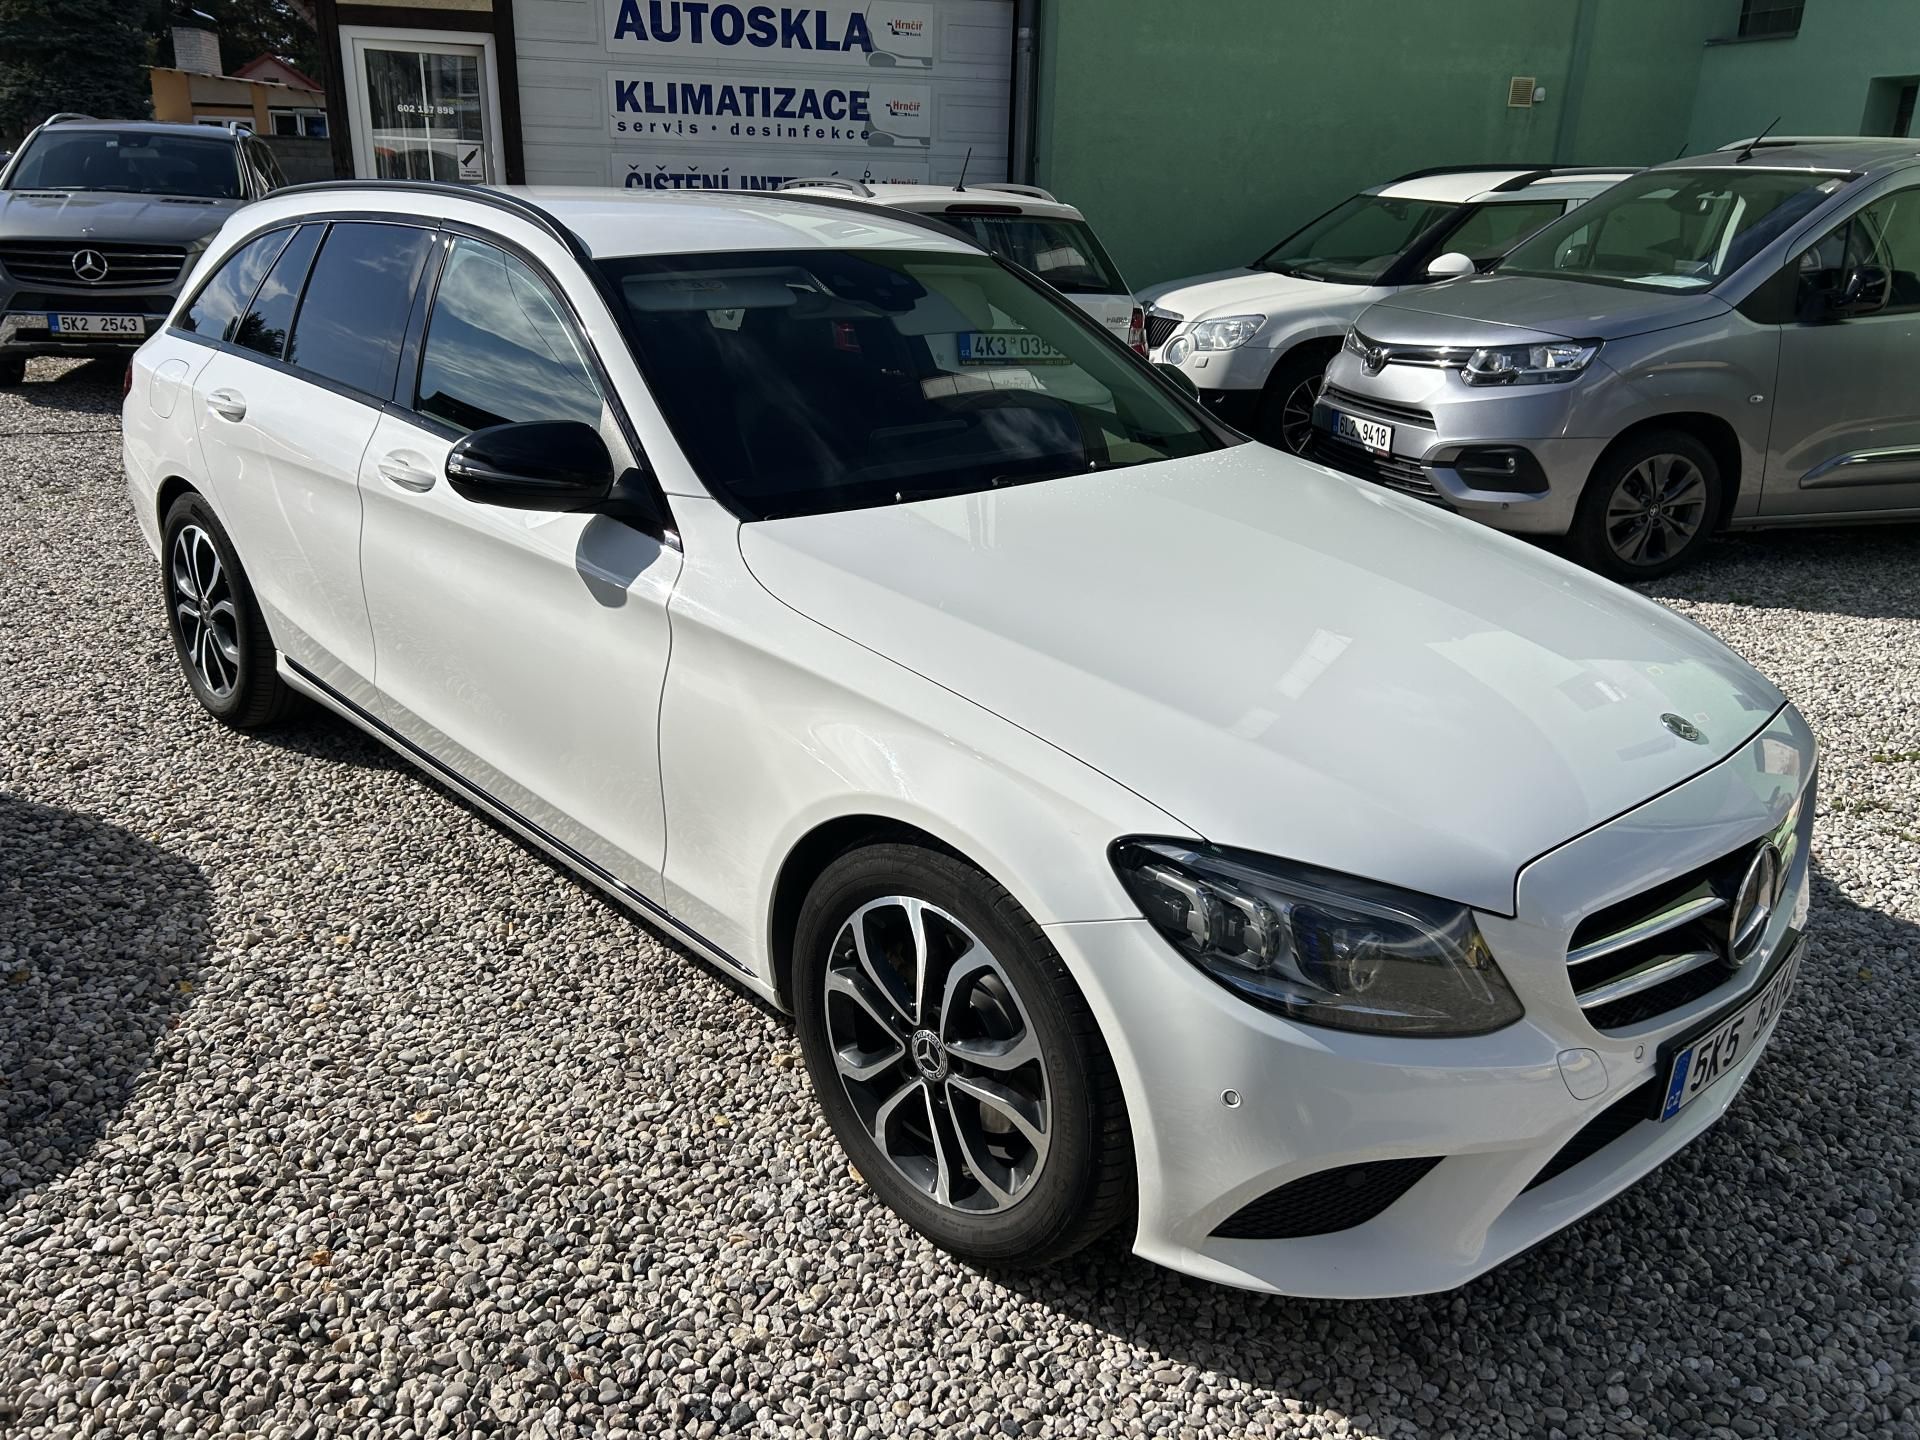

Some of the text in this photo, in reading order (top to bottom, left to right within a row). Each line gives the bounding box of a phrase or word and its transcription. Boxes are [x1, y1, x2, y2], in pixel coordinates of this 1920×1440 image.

[614, 0, 873, 53] AUTOSKLA
[397, 104, 415, 113] 602
[417, 105, 434, 114] 17
[615, 80, 870, 121] KLIMATIZACE
[617, 120, 870, 140] servis desinfekce
[61, 317, 89, 331] 5K2
[100, 318, 137, 332] 2543
[975, 337, 1007, 356] 4K3
[1339, 416, 1356, 437] 6L2
[1362, 423, 1387, 447] 9418
[1690, 1016, 1745, 1092] 5K5
